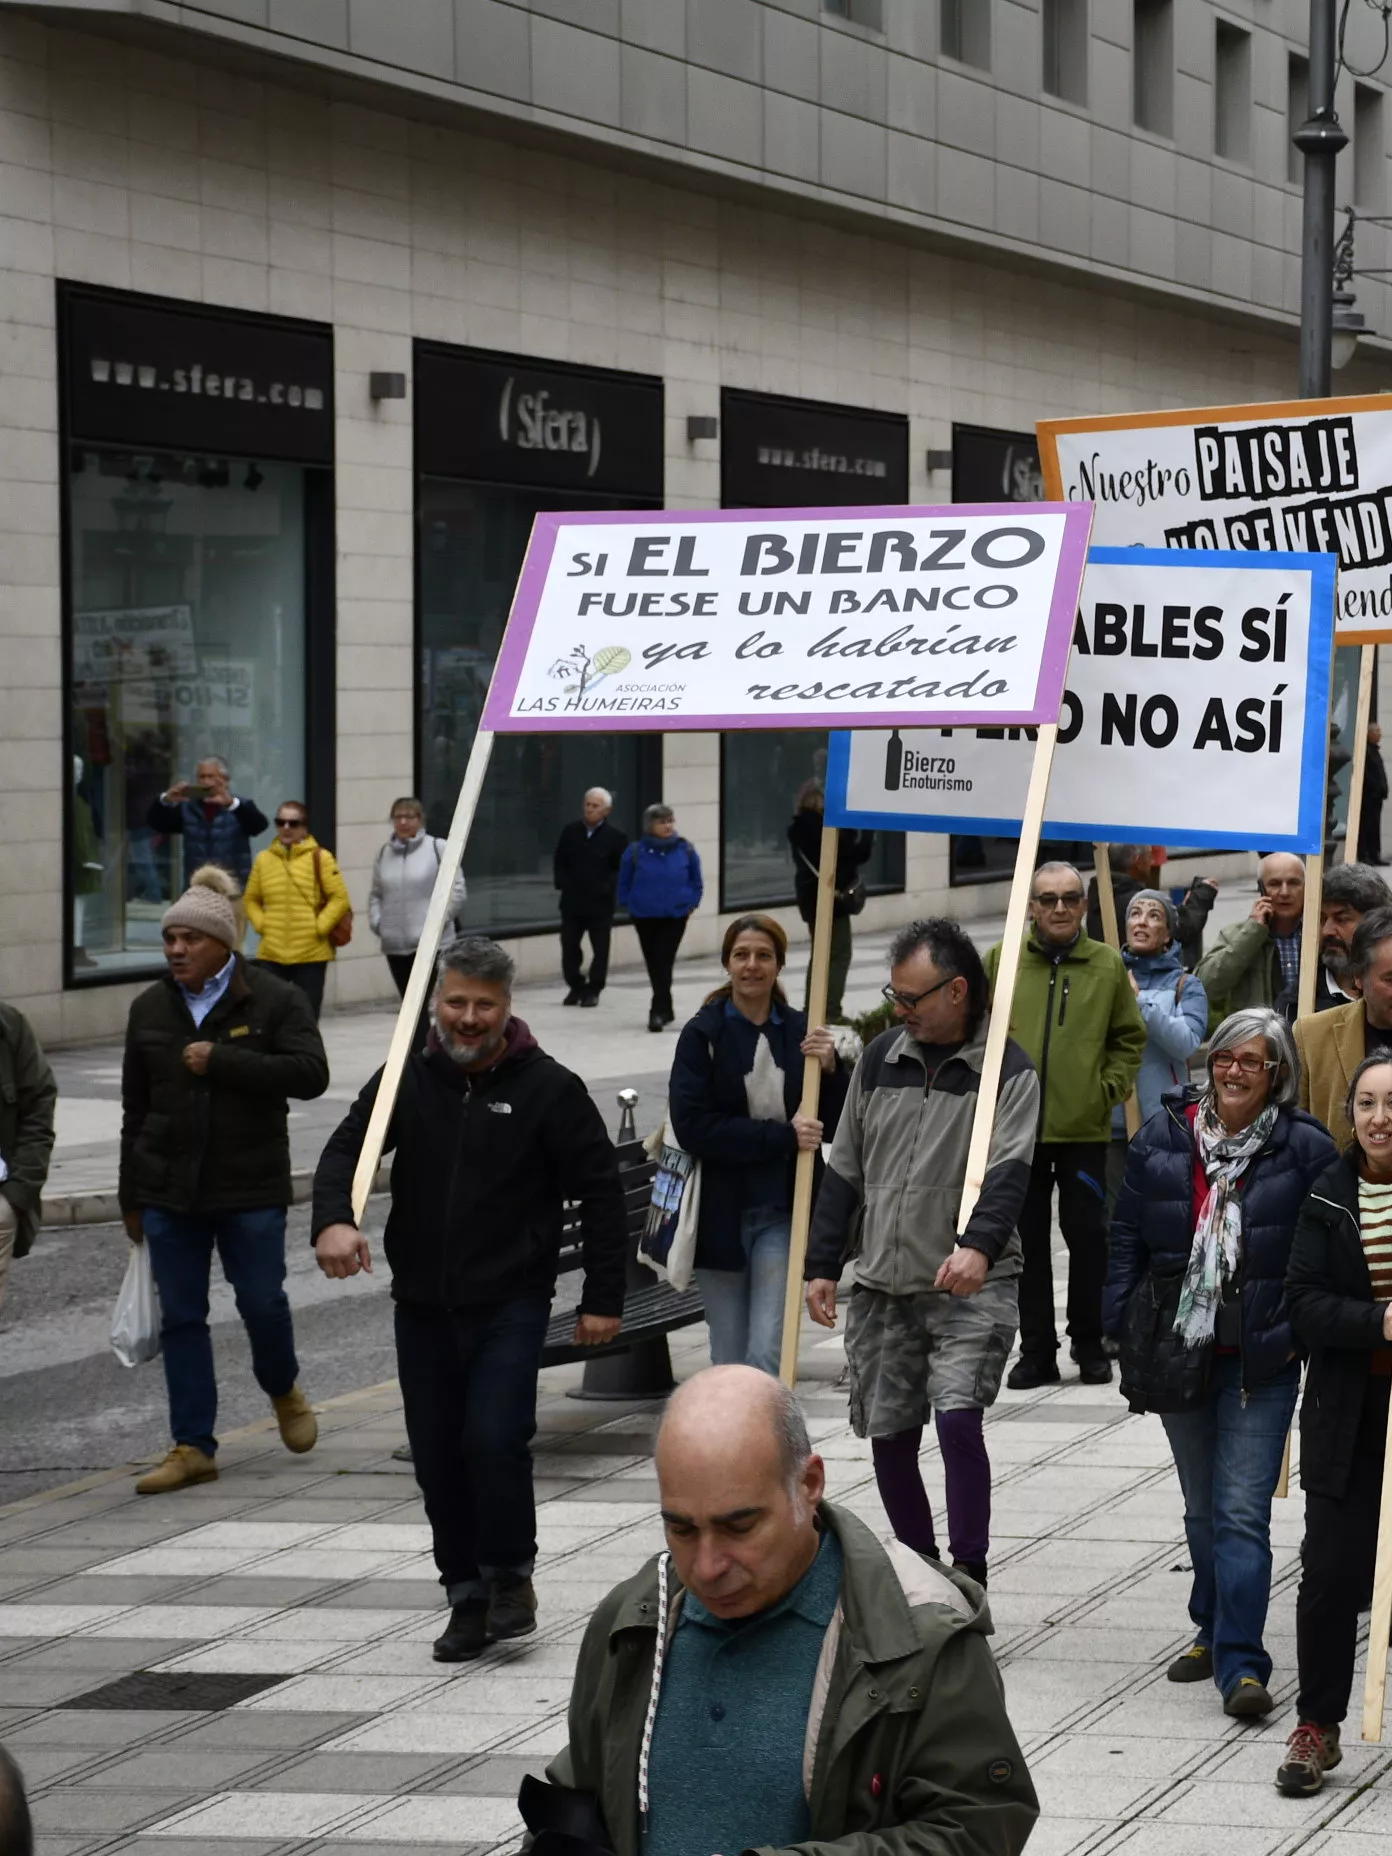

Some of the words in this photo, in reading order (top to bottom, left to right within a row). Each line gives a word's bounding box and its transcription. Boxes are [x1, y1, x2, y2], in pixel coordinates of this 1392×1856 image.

[91, 360, 323, 409] www.sfera.com
[1068, 453, 1190, 507] Nuestro
[1199, 427, 1355, 494] PAISAJE
[567, 552, 607, 577] SI
[627, 536, 709, 577] EL
[740, 526, 1045, 576] BIERZO
[578, 591, 719, 617] FUESE
[738, 591, 811, 616] UN
[829, 584, 1019, 614] BANCO
[641, 640, 710, 670] ya
[735, 630, 783, 659] lo
[807, 624, 1018, 658] habrían
[1239, 593, 1293, 663] SÍ
[517, 697, 559, 712] LAS
[564, 697, 682, 712] HUMEIRAS
[615, 684, 686, 693] ASOCIACIÓN
[747, 670, 1009, 700] rescatado
[1100, 692, 1179, 749] NO
[1193, 683, 1289, 754] ASÍ
[903, 750, 956, 775] Bierzo
[902, 773, 973, 793] Enoturismo
